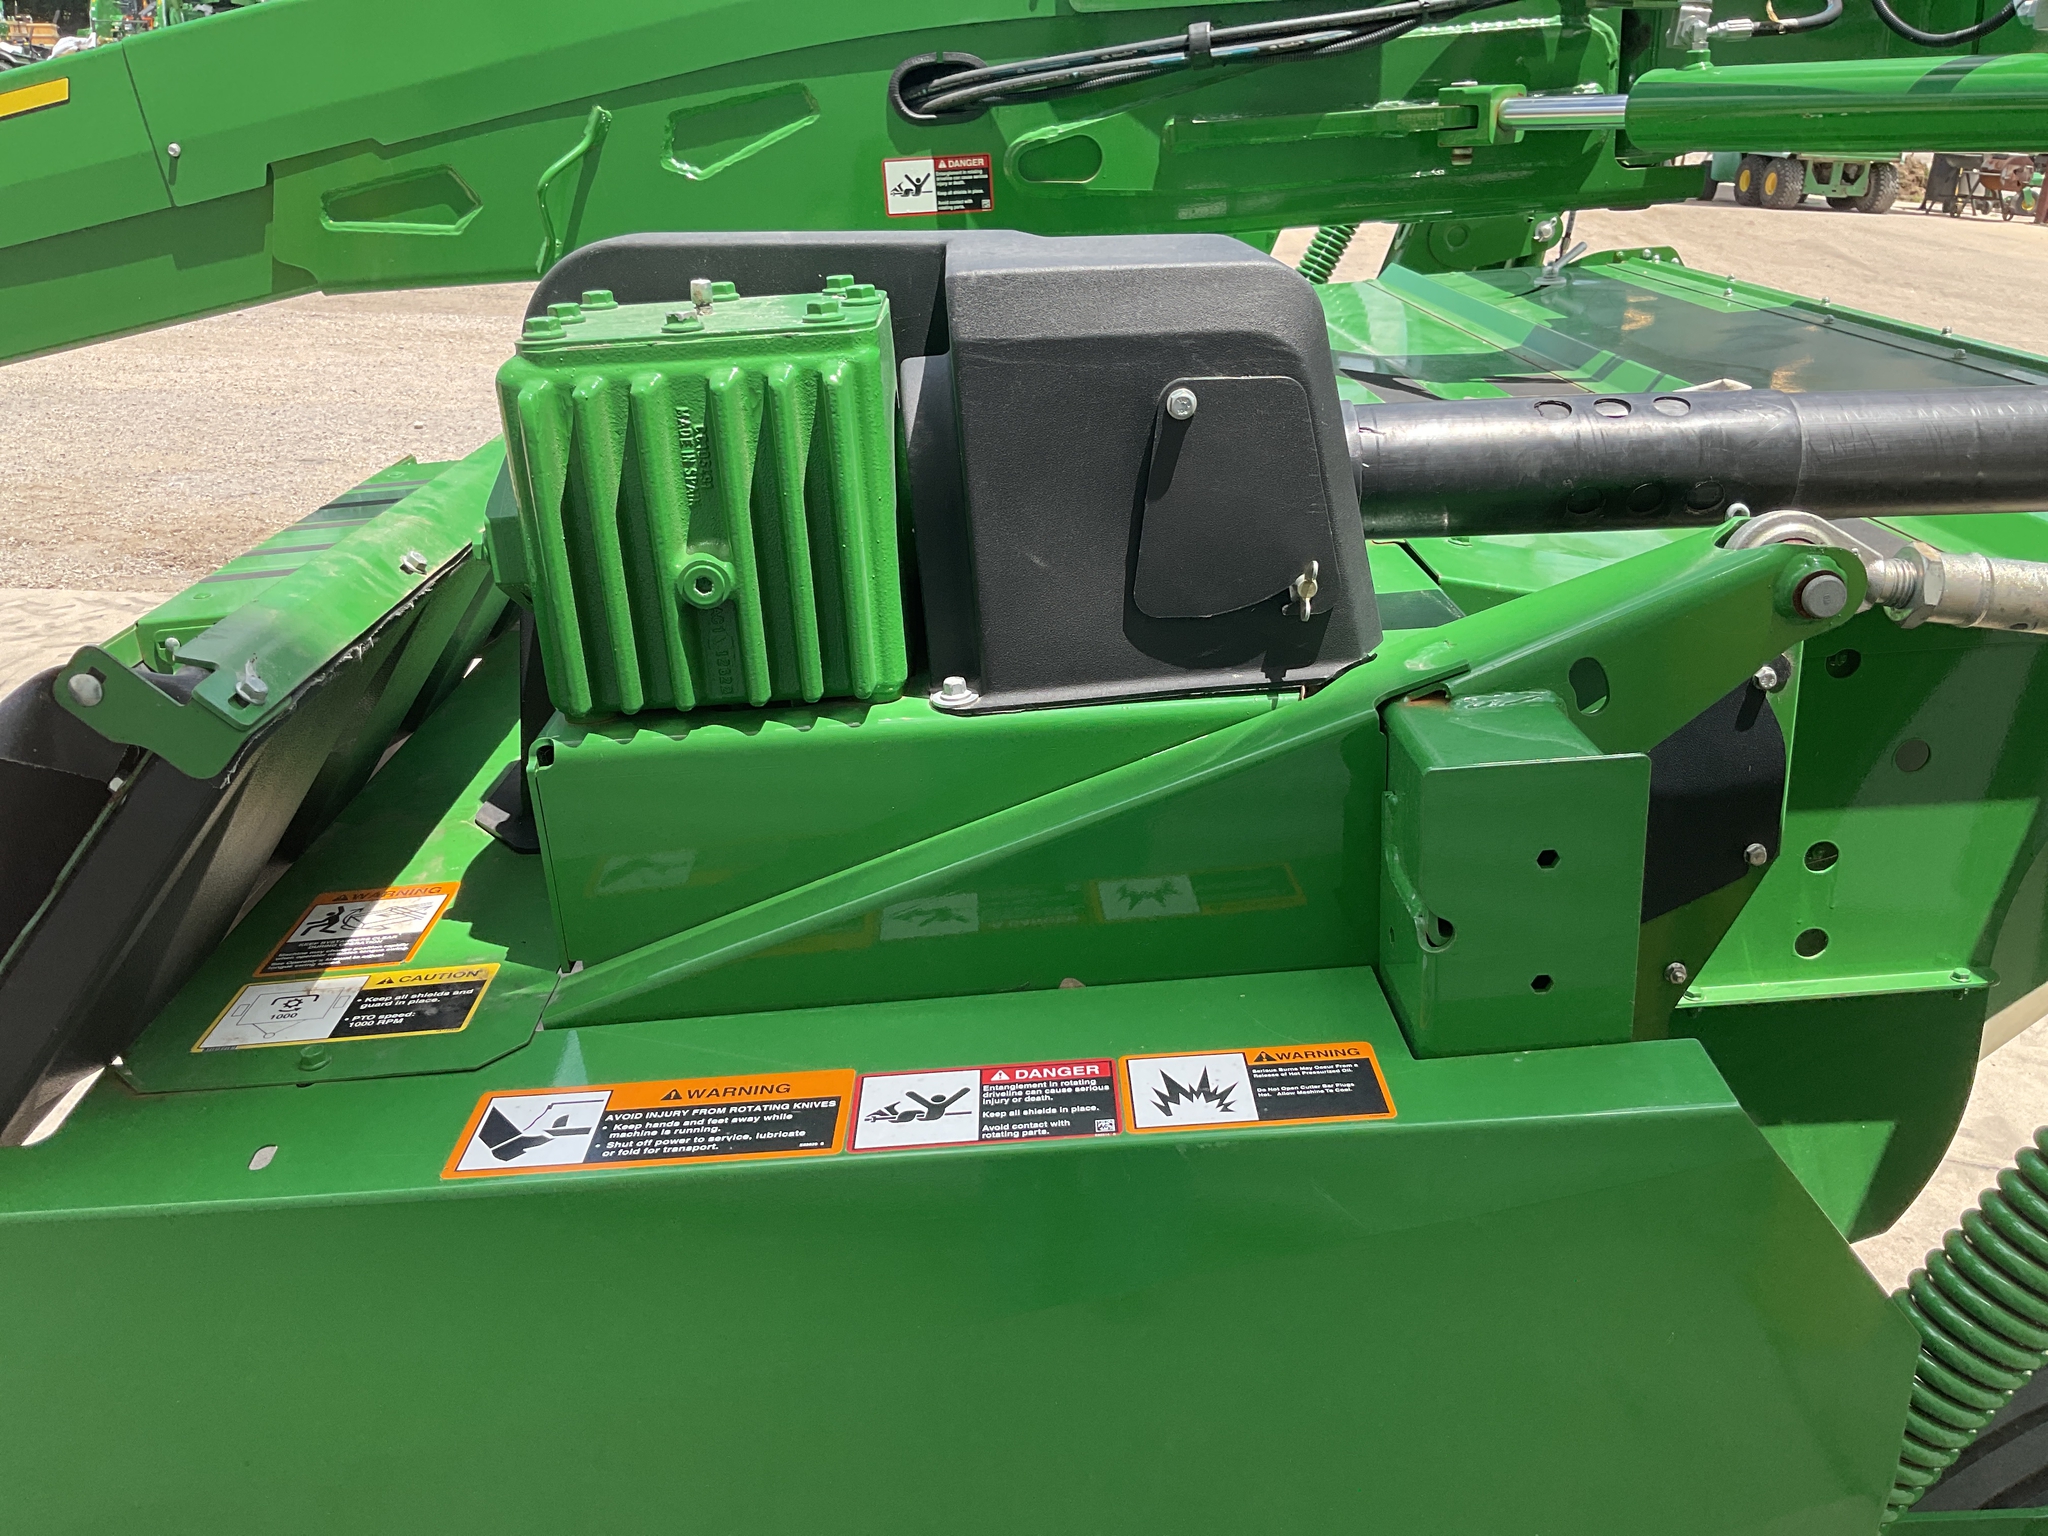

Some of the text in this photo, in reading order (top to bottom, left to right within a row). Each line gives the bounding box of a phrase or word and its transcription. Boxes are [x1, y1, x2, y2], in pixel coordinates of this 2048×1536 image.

[948, 158, 984, 168] DANGER
[352, 886, 442, 900] WARNING
[398, 970, 480, 982] CAUTION
[452, 988, 474, 996] and
[360, 1002, 392, 1010] guard
[407, 998, 440, 1006] place.
[270, 1012, 298, 1020] 1000
[378, 1012, 416, 1020] speed:
[348, 1018, 404, 1028] 1000 RPM
[1276, 1048, 1360, 1060] WARNING
[1016, 1065, 1100, 1080] DANGER
[688, 1084, 791, 1098] WARNING
[982, 1089, 1023, 1098] driveline
[1074, 1084, 1110, 1092] serious
[983, 1082, 1047, 1092] Entanglement
[1060, 1079, 1096, 1087] rotating
[982, 1096, 1010, 1106] injury
[1024, 1094, 1054, 1102] death.
[605, 1100, 836, 1121] AVOID INJURY FROM ROTATING KNIVES
[982, 1110, 1006, 1119] Keep
[1022, 1106, 1058, 1116] shields
[1071, 1104, 1100, 1114] place.
[613, 1122, 642, 1132] Keep
[645, 1120, 680, 1129] hands
[683, 1118, 706, 1126] and
[731, 1116, 760, 1124] away
[764, 1113, 794, 1122] while
[982, 1124, 1010, 1132] Avoid
[1012, 1120, 1048, 1130] contact
[610, 1126, 721, 1139] machine is running.
[982, 1129, 1050, 1139] rotating parts.
[606, 1140, 633, 1149] Shut
[636, 1139, 654, 1147] off
[654, 1138, 691, 1148] power
[708, 1134, 752, 1142] service,
[756, 1130, 806, 1140] lubricate
[618, 1148, 640, 1156] fold
[644, 1146, 660, 1154] for
[662, 1144, 719, 1153] transport.
